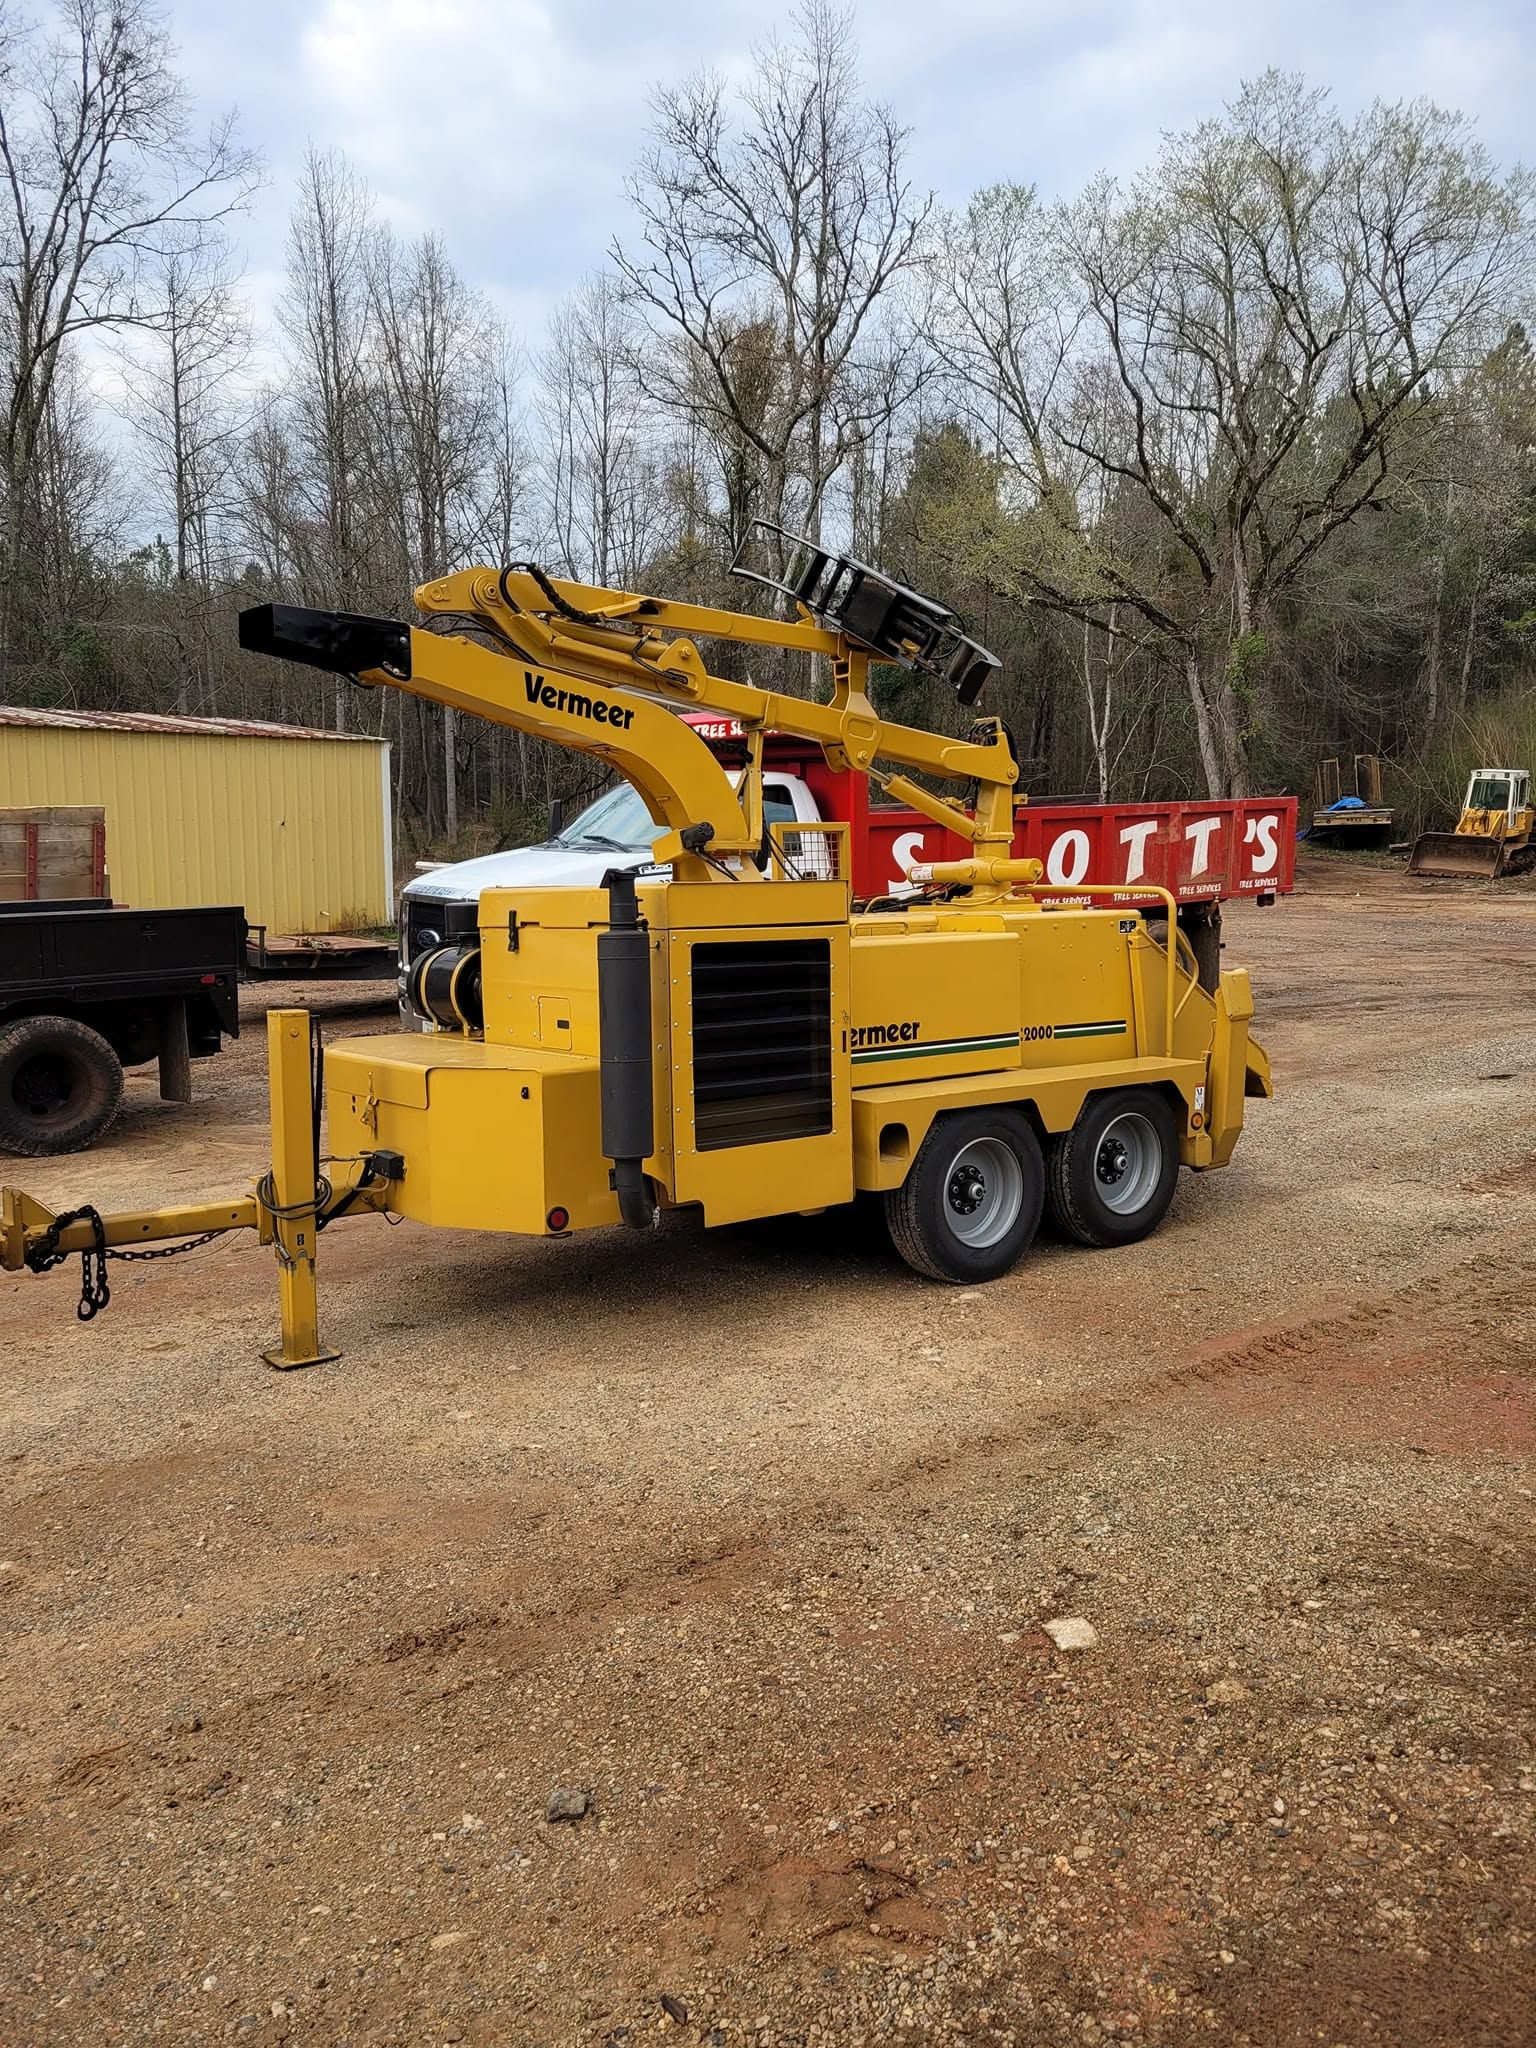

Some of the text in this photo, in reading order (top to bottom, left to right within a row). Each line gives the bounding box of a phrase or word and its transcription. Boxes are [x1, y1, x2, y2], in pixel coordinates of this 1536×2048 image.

[524, 671, 635, 730] Vermeer
[1179, 883, 1222, 895] TREE SERVICES
[1240, 877, 1278, 888] TREE SERVICES
[842, 1021, 920, 1052] ermeer
[1020, 1024, 1053, 1041] 2000
